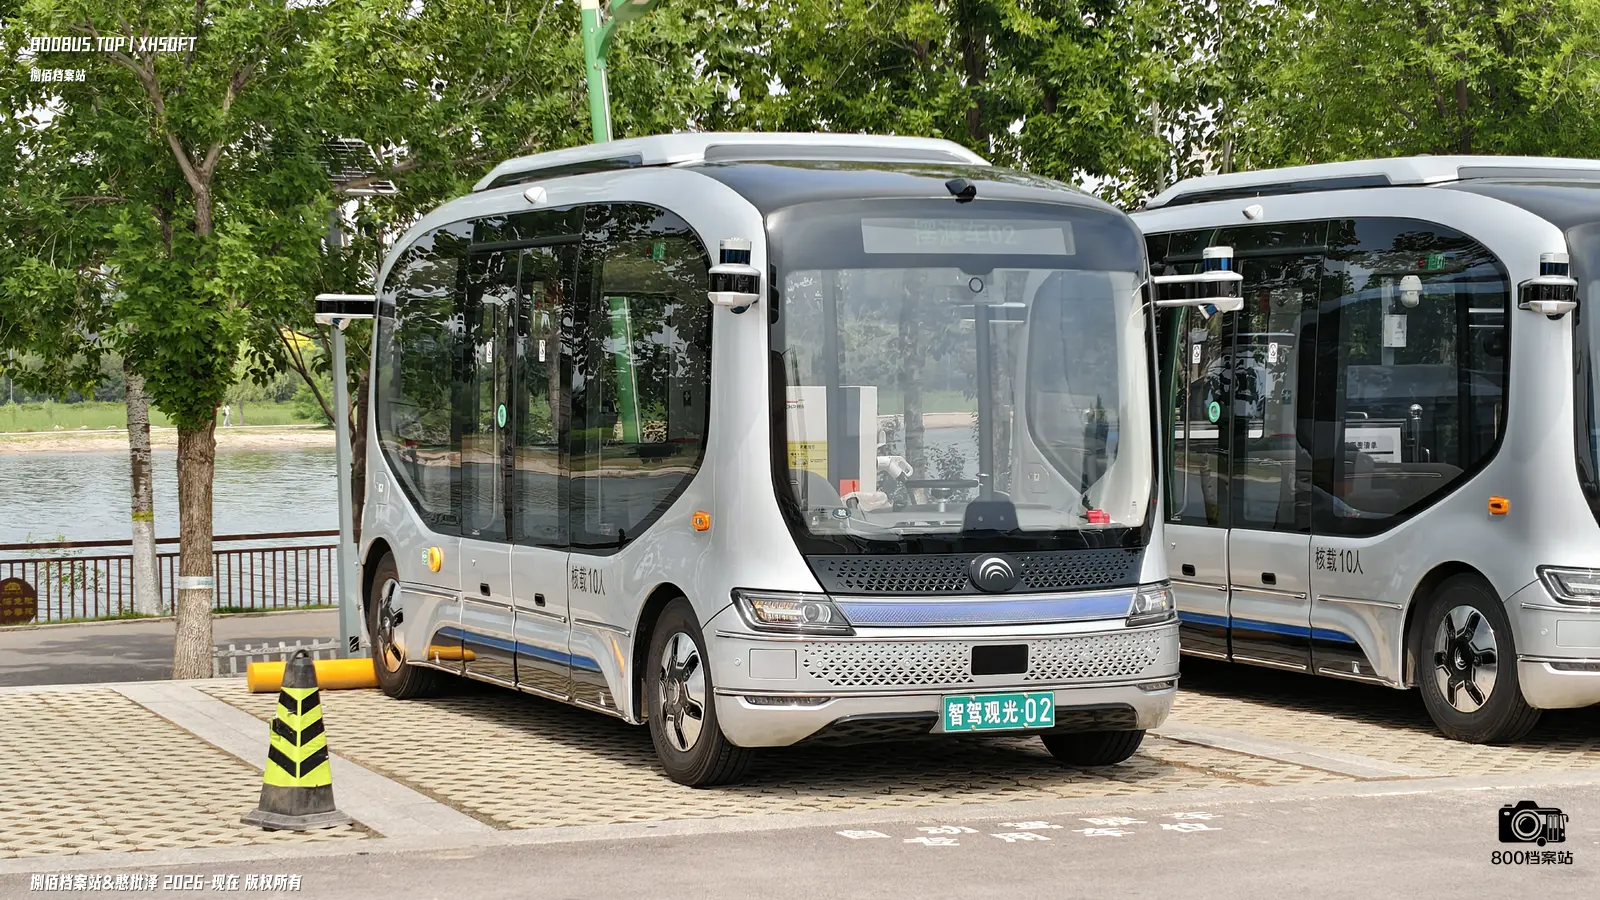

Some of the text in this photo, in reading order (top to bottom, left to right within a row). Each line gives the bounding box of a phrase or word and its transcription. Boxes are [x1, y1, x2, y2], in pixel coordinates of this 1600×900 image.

[914, 219, 1018, 246] 摆渡车02
[1315, 547, 1363, 574] 核载10人
[571, 565, 605, 595] 核载10人
[948, 697, 1051, 726] 智驾观光·02
